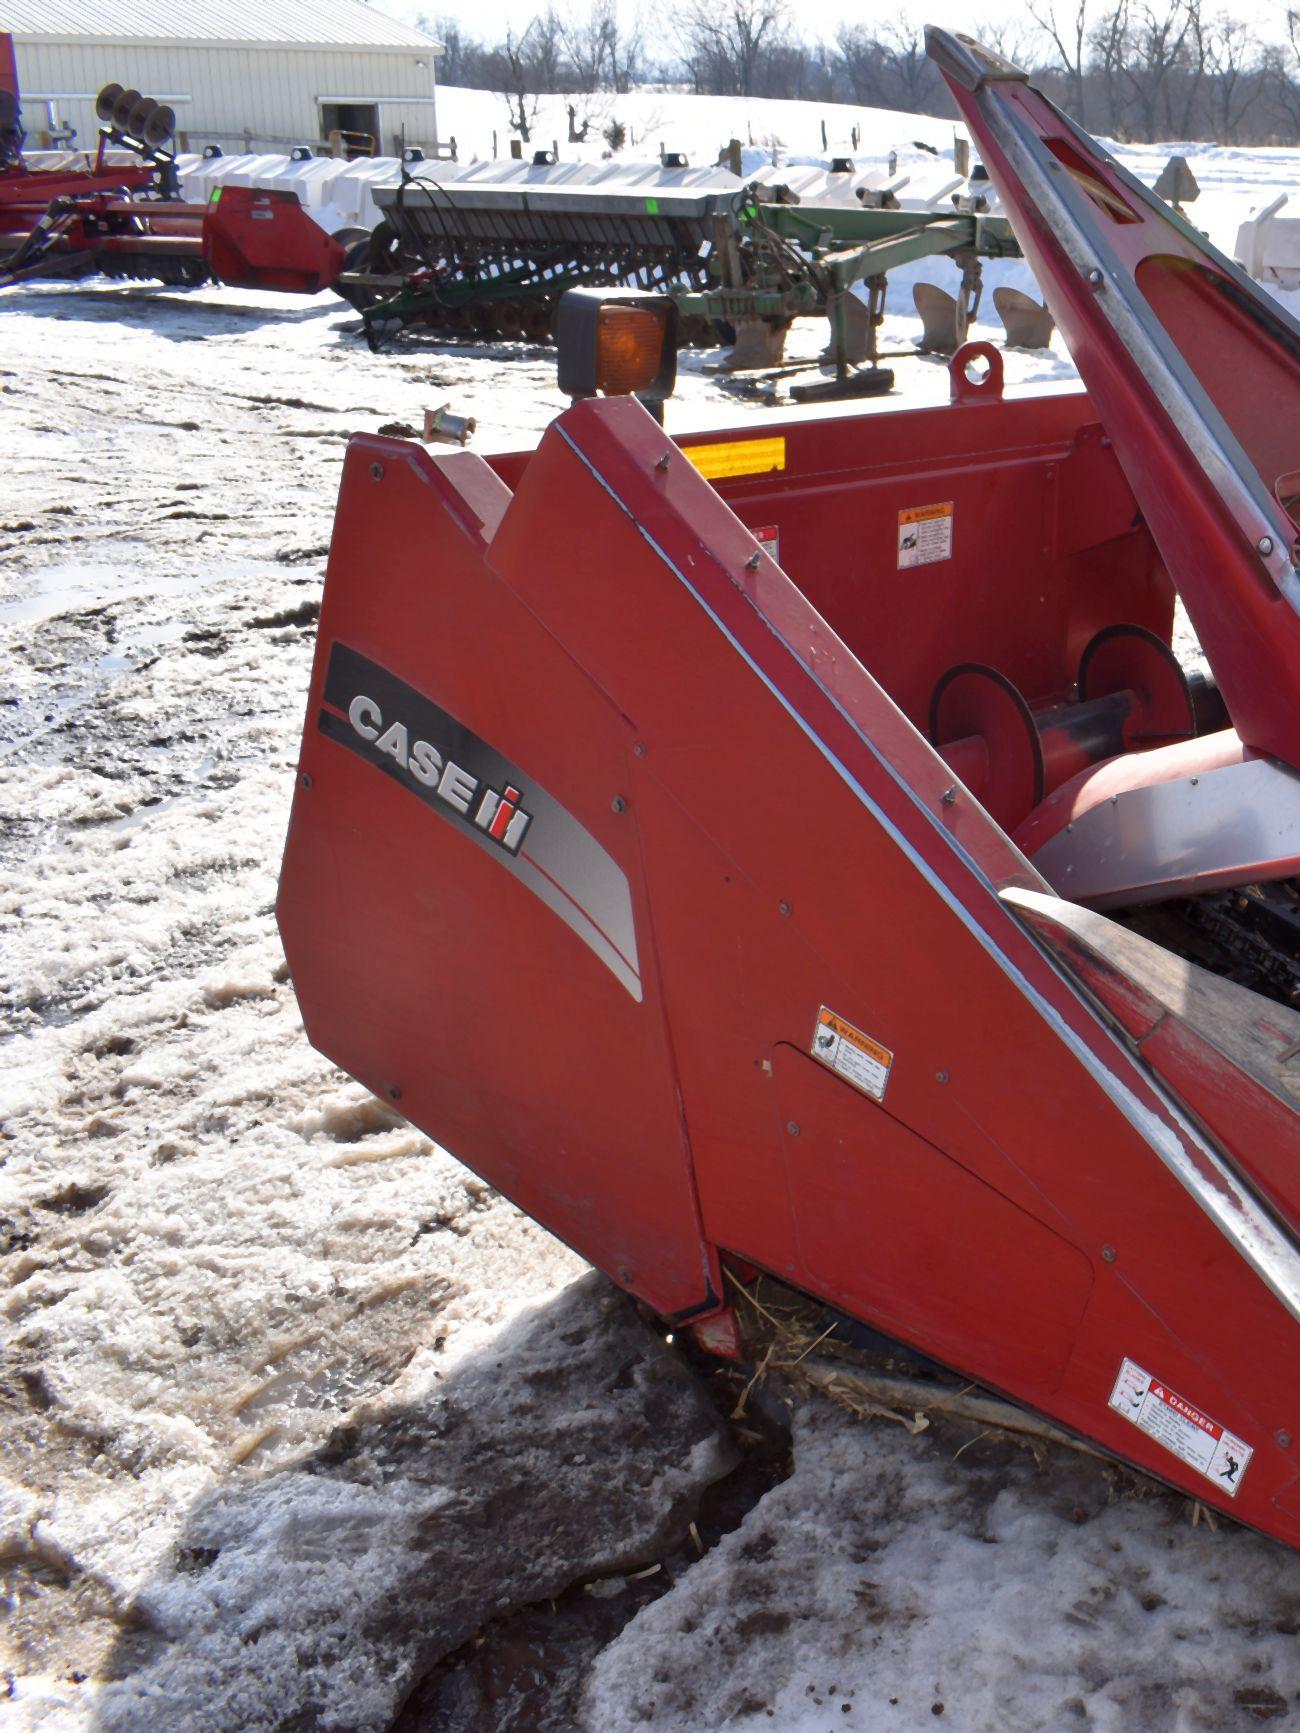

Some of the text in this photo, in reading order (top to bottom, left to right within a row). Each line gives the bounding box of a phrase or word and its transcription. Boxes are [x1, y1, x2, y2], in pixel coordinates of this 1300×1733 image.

[349, 695, 480, 814] CASE
[840, 1025, 884, 1061] WARNING
[1168, 1394, 1215, 1432] DANGER
